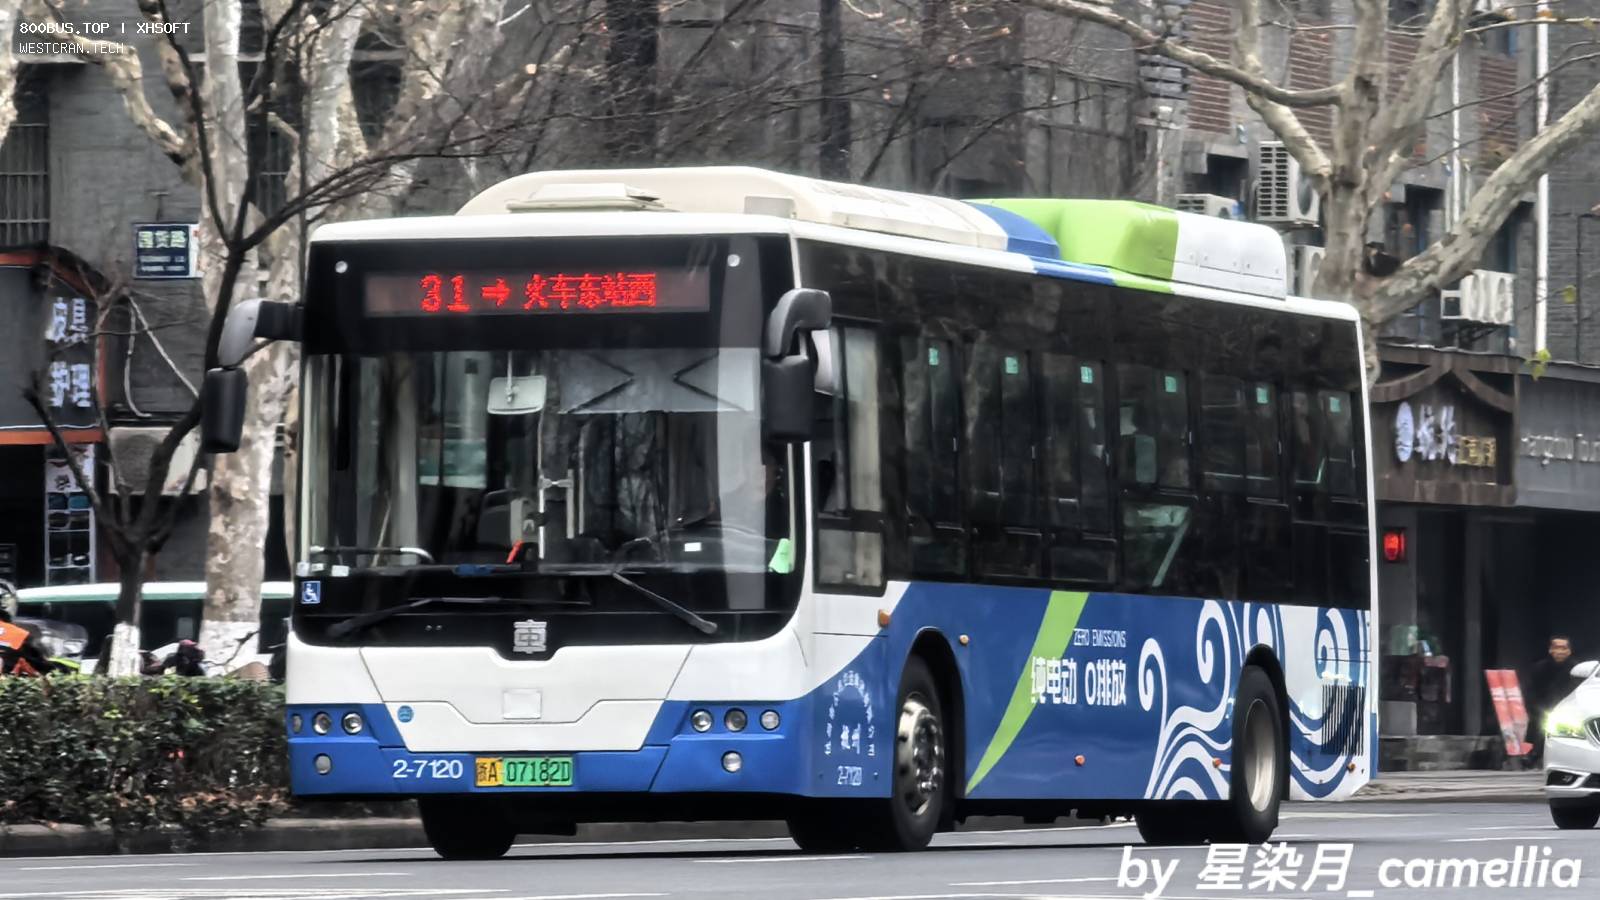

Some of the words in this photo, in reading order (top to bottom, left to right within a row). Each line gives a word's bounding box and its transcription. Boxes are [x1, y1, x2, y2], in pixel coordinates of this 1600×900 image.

[420, 274, 470, 312] 31
[522, 272, 656, 310] 火车东站西
[1073, 628, 1090, 646] ZERO
[1092, 629, 1127, 648] EMISSIONS
[1031, 656, 1077, 704] 纯电动
[393, 759, 463, 779] 2-7120
